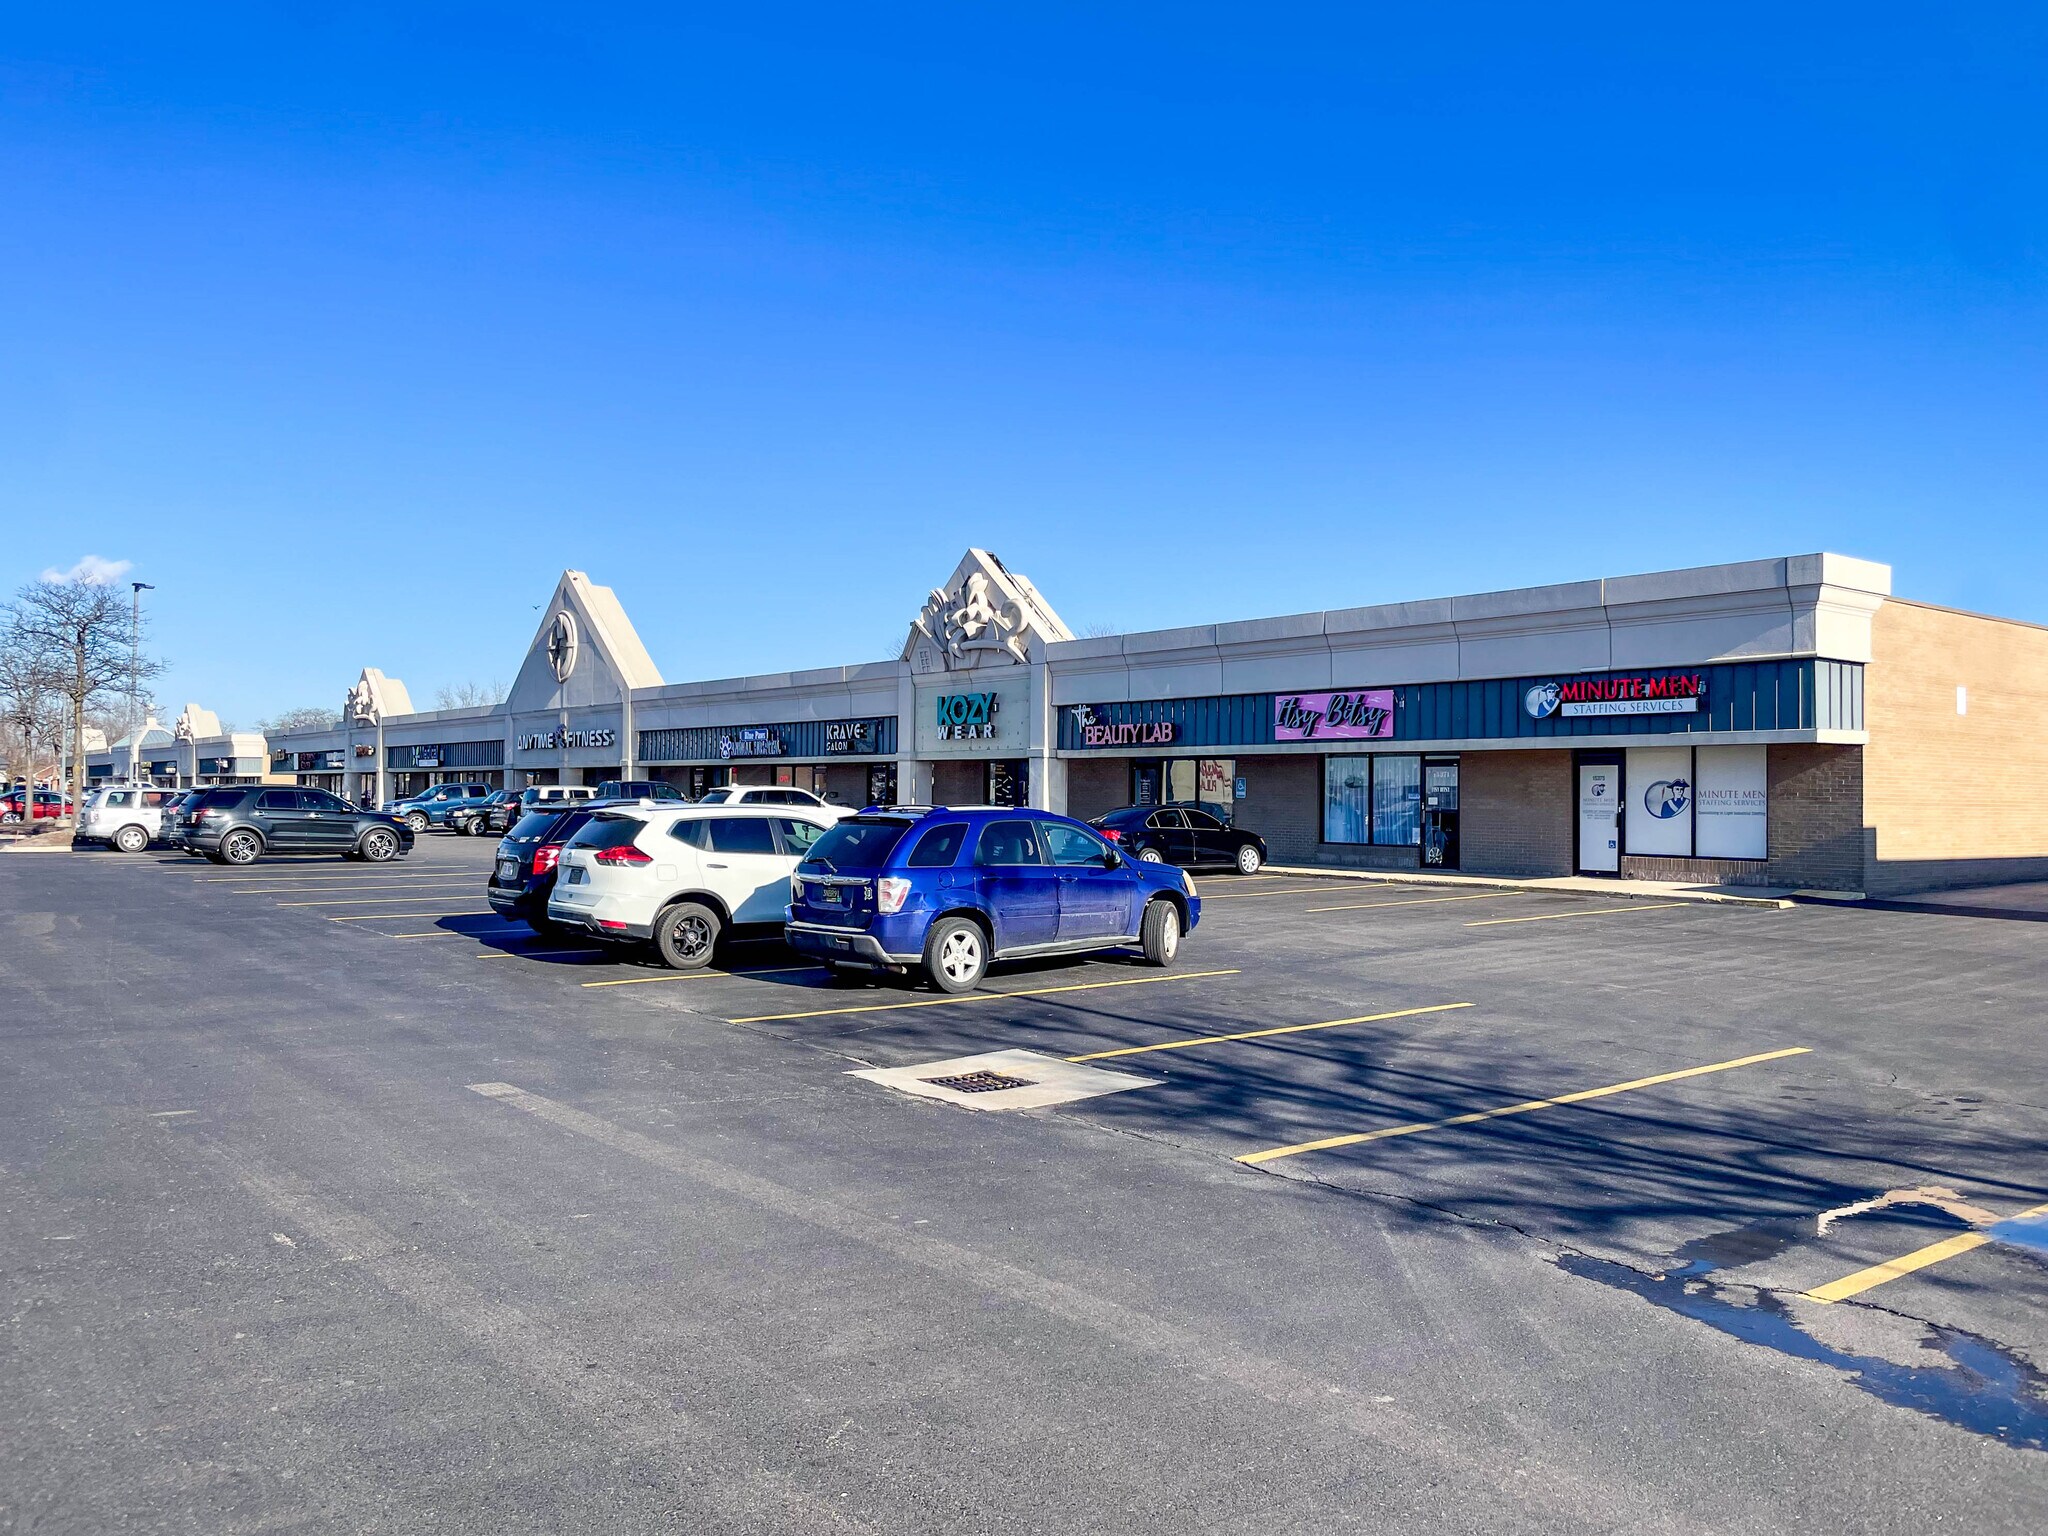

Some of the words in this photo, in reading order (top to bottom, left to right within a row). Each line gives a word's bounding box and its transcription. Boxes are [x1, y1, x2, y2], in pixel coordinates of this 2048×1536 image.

[1562, 678, 1642, 700] MINUTE
[1649, 675, 1698, 697] MEN
[937, 692, 994, 726] KOZY
[1273, 697, 1323, 737] Itsy
[1324, 694, 1392, 736] Bitsy
[1573, 703, 1626, 714] STAFFING
[1630, 700, 1683, 712] SERVICES
[1071, 704, 1097, 733] The
[517, 732, 554, 750] ANYTIME
[566, 729, 610, 748] FITNESS
[826, 723, 864, 740] KRAVE
[937, 724, 993, 740] WEAR
[1085, 723, 1141, 745] BEAUTY
[1142, 722, 1173, 743] LAB
[826, 741, 848, 751] SALON
[1698, 789, 1739, 799] MINUTE
[1742, 789, 1766, 799] MEN
